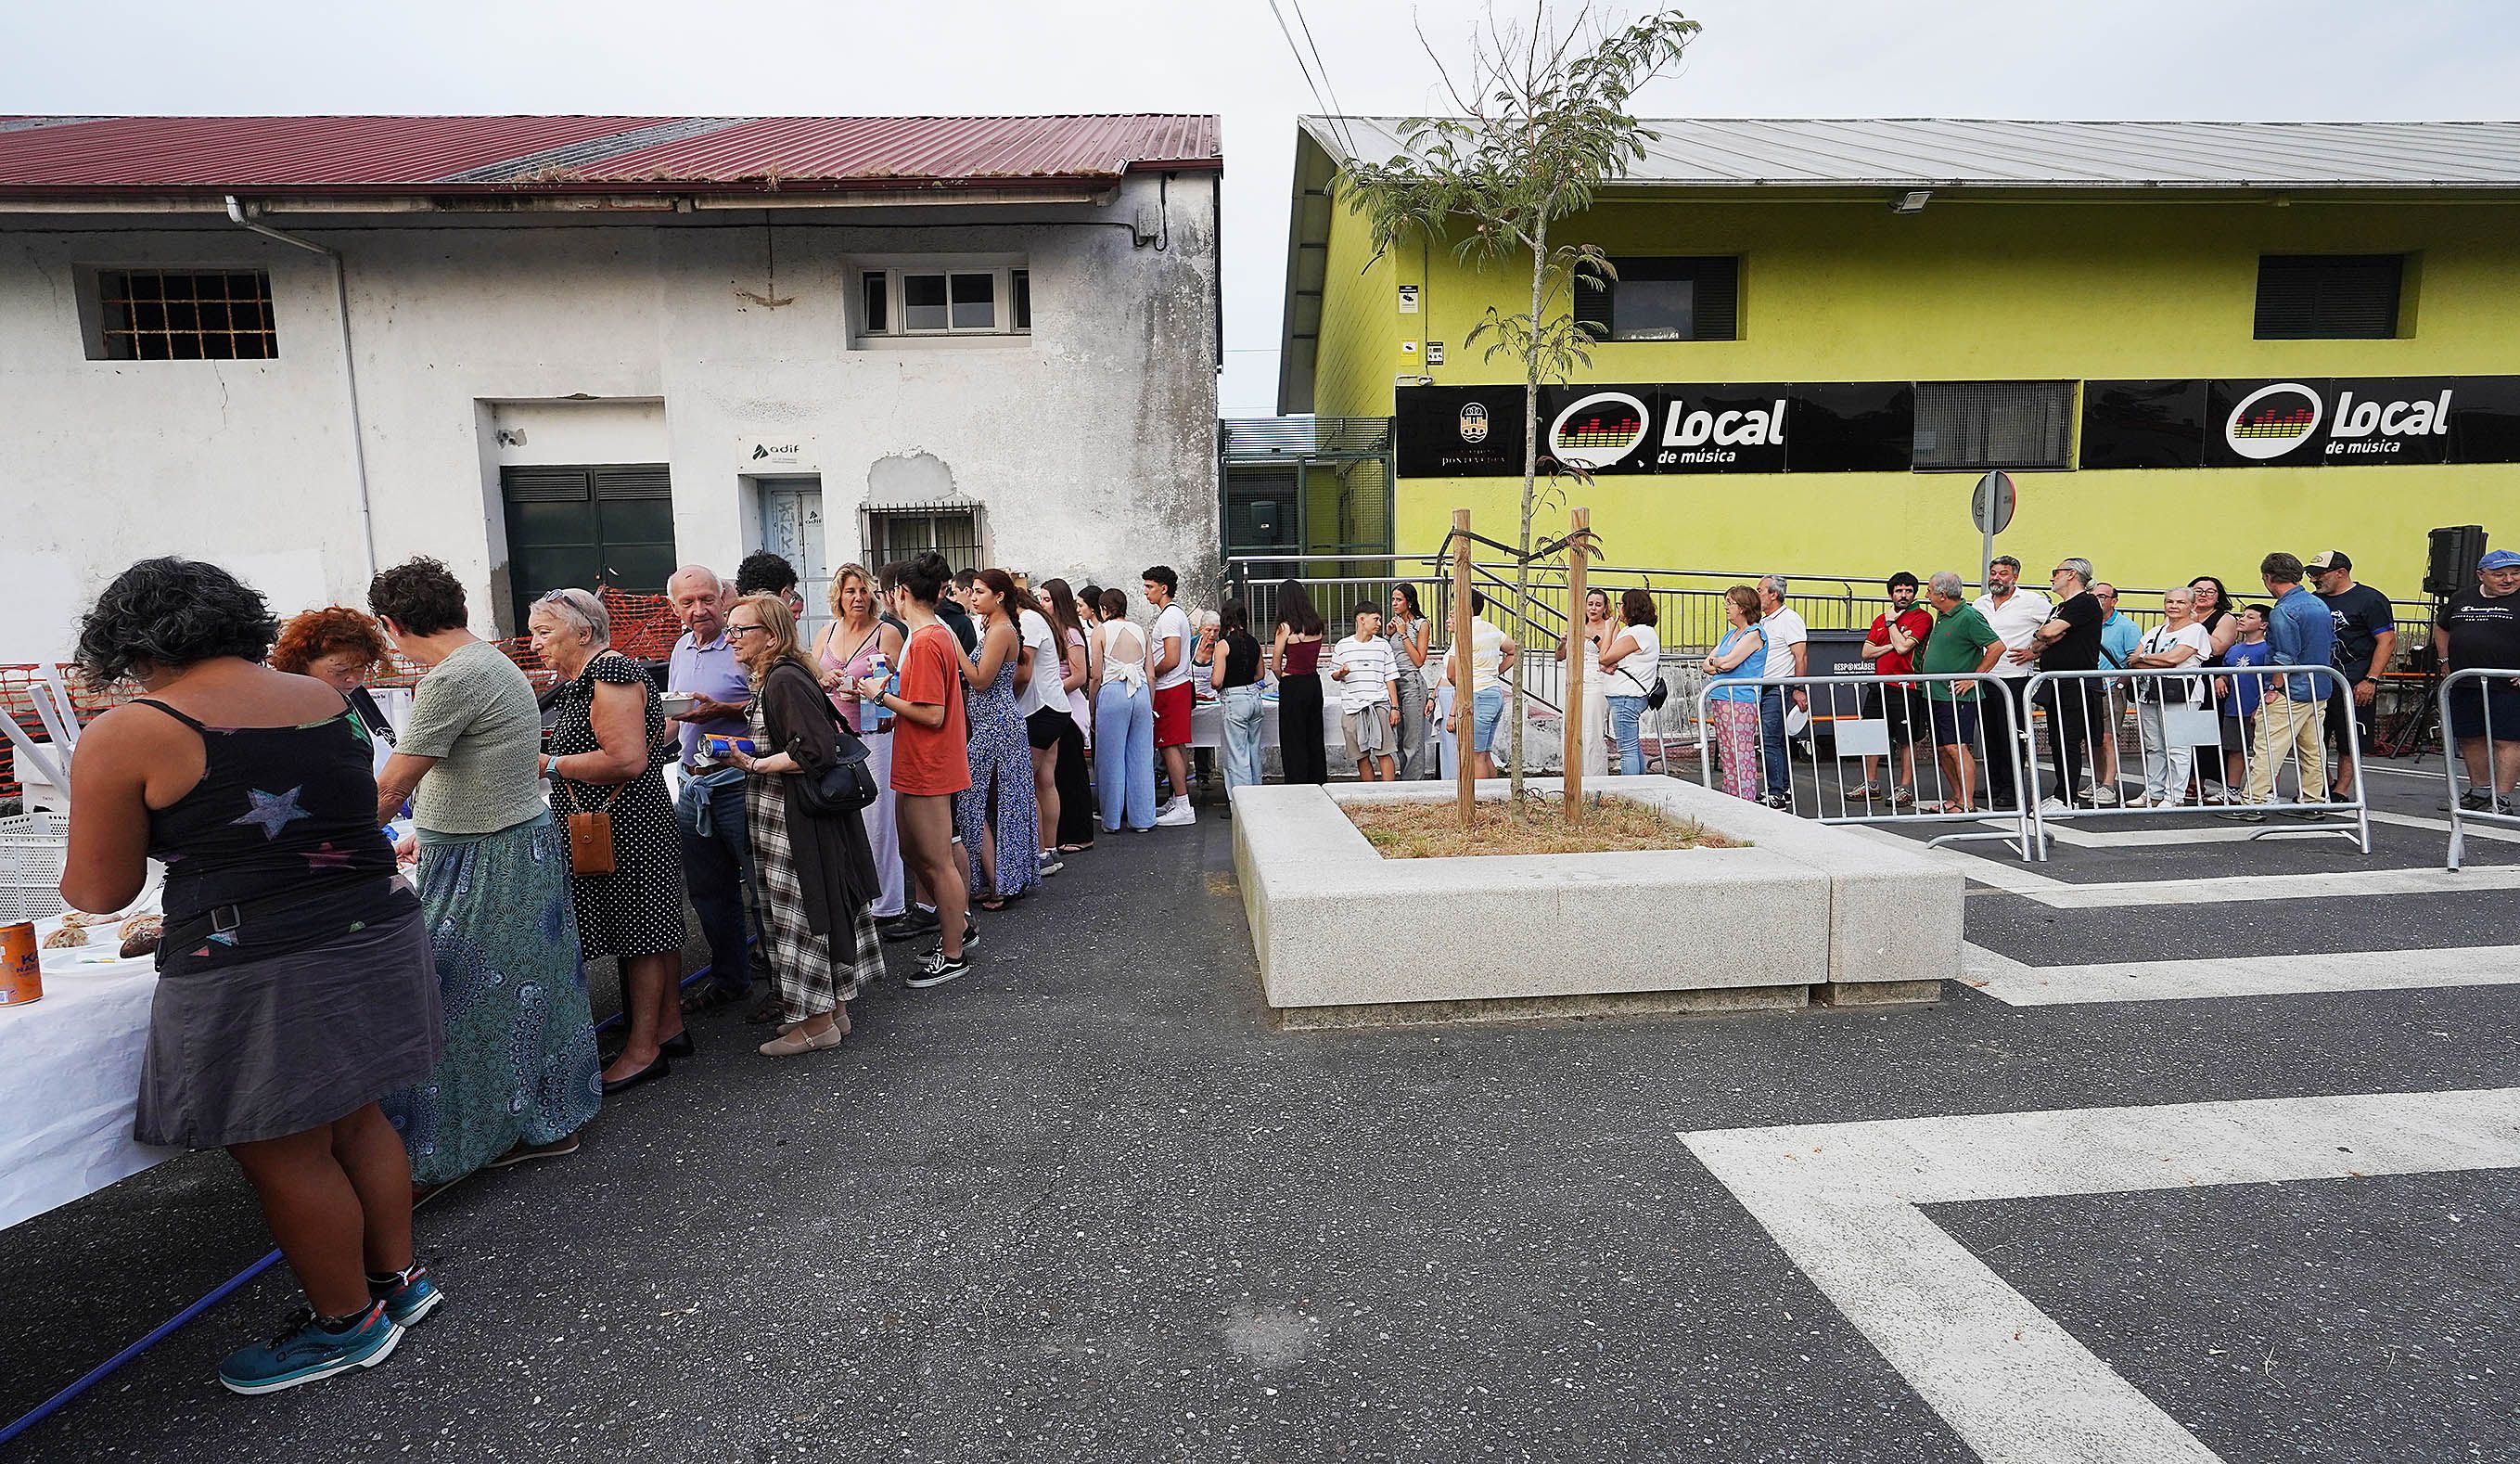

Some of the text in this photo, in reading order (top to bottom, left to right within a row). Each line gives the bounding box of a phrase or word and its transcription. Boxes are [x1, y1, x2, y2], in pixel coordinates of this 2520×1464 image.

[2330, 390, 2453, 438] Local
[1662, 399, 1786, 447] Local
[770, 445, 799, 454] adif
[2325, 439, 2400, 455] de música
[1657, 448, 1736, 464] de música
